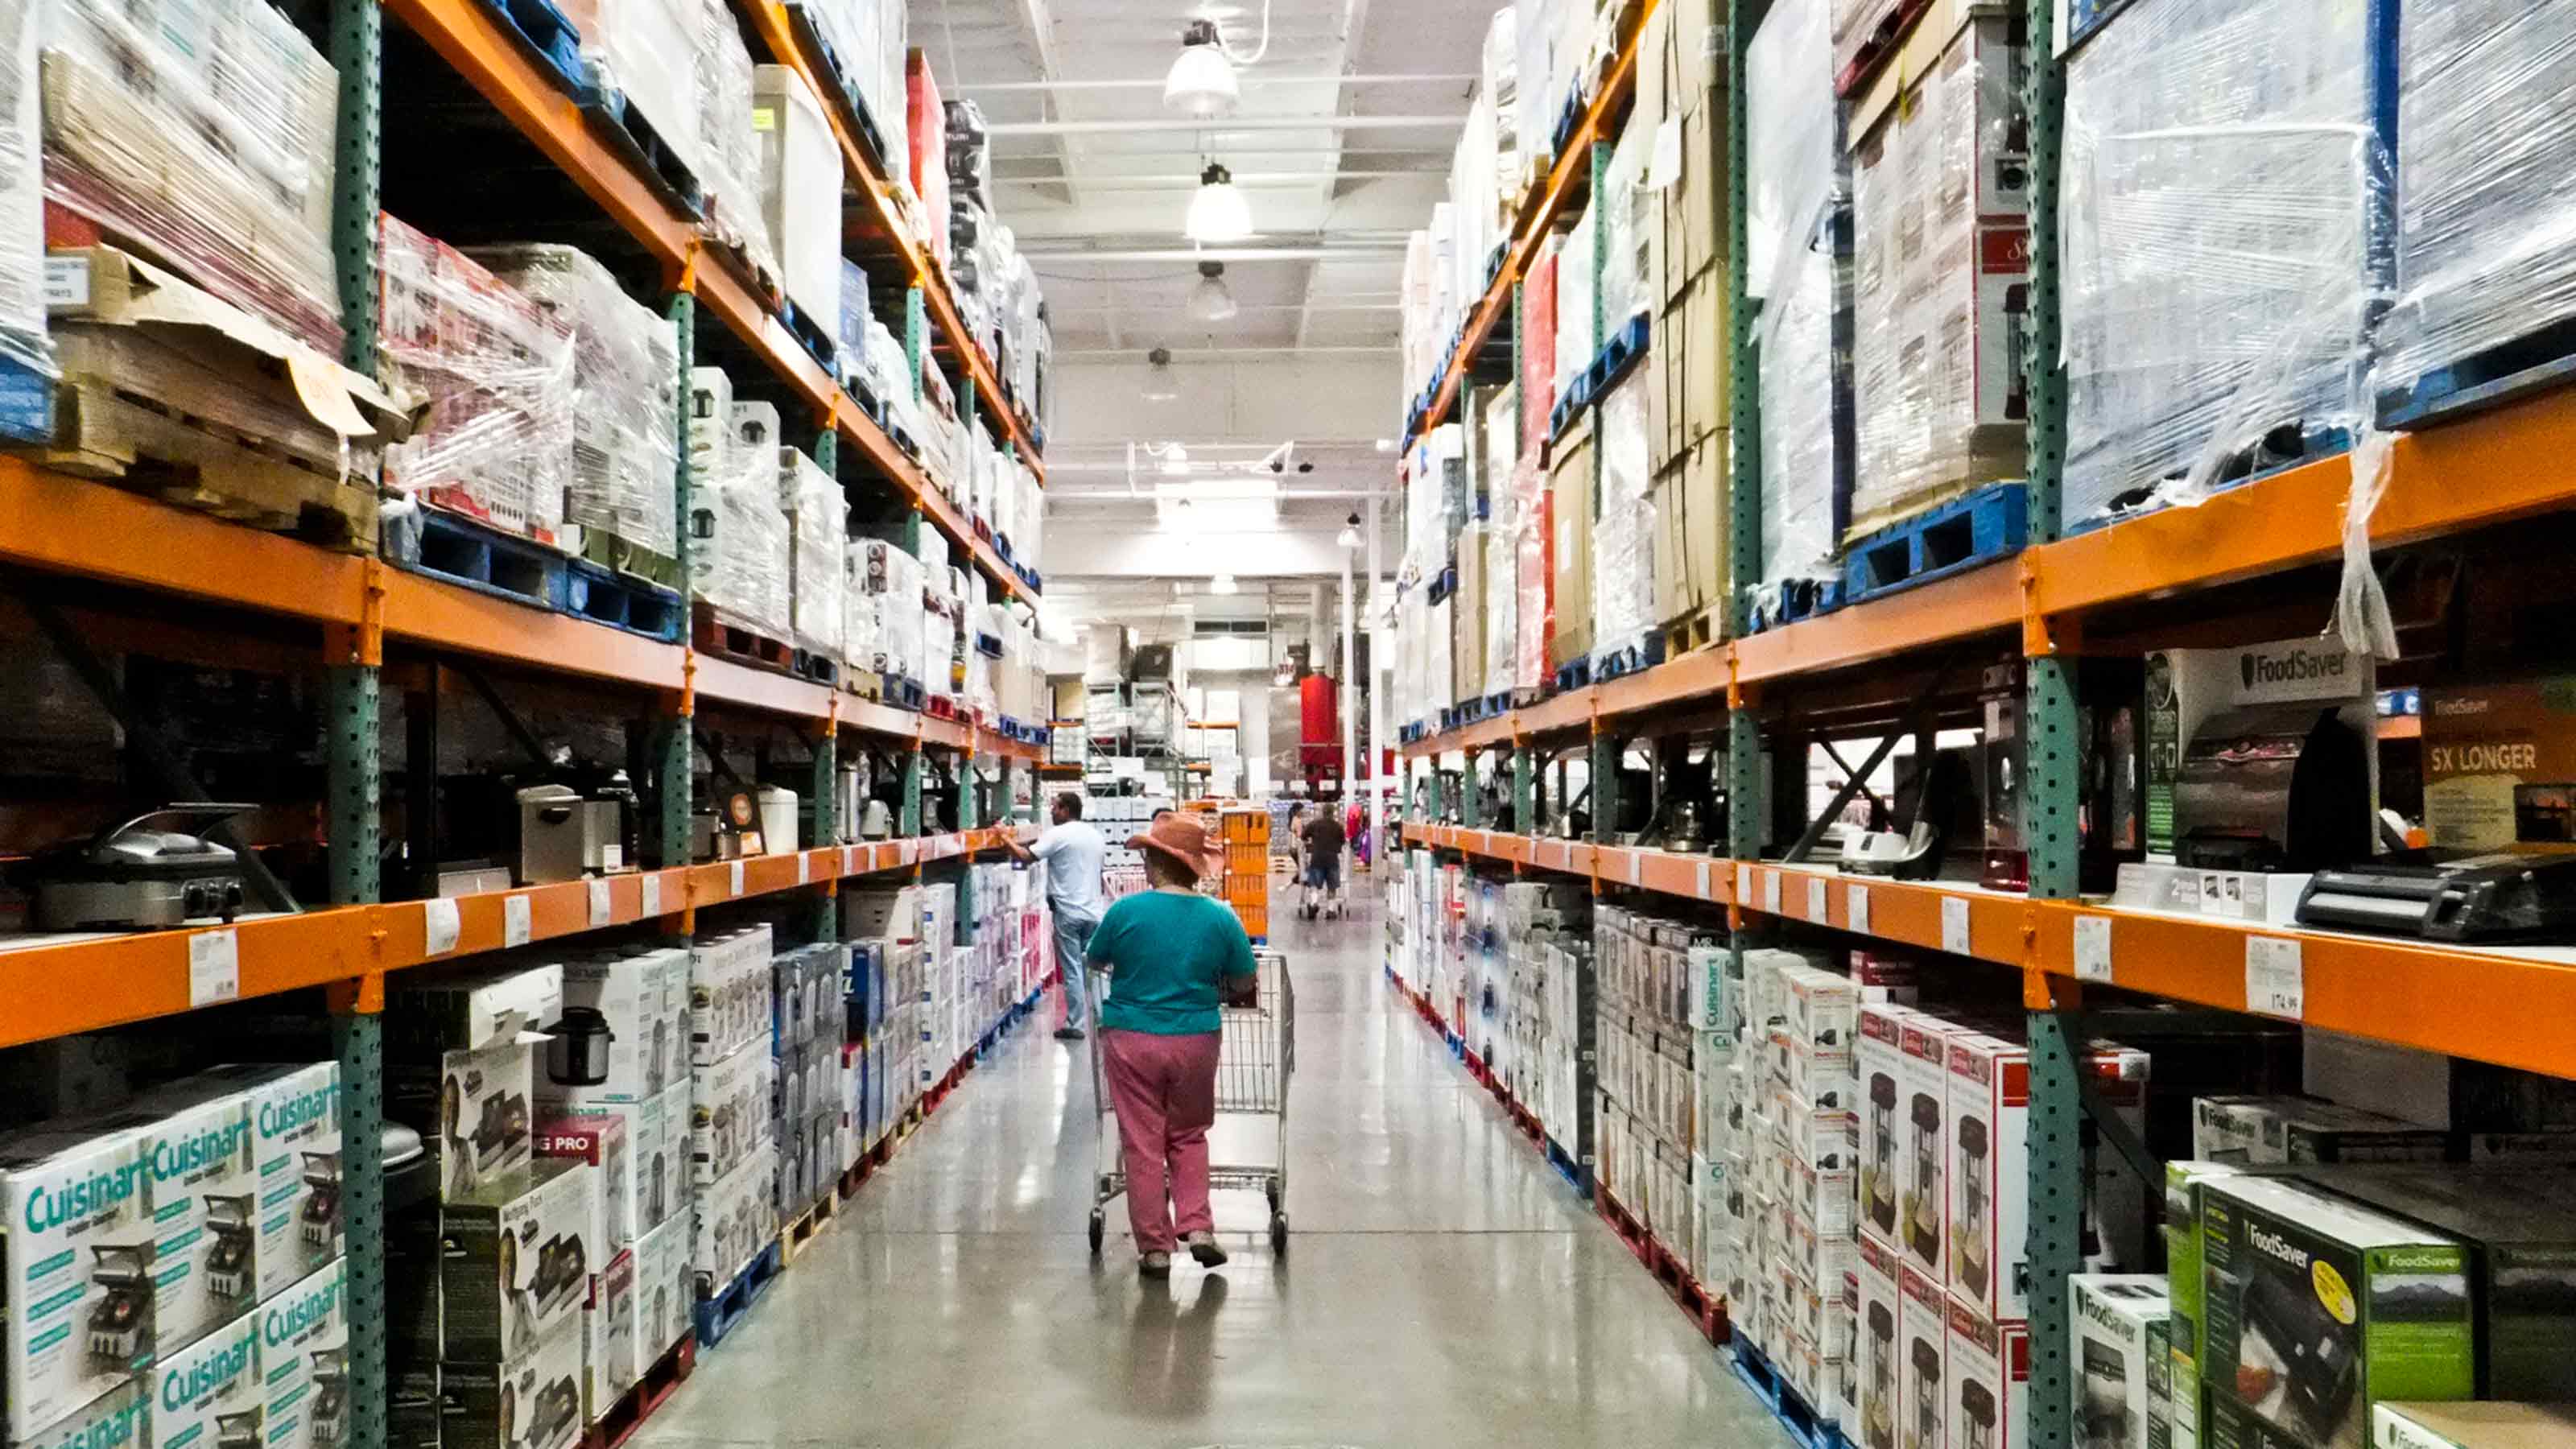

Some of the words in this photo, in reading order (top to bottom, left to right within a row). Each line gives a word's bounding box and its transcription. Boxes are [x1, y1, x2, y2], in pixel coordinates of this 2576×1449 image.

[2256, 650, 2346, 683] FoodSaver
[2459, 744, 2536, 770] LONGER
[259, 1080, 341, 1139] Cuisinart
[152, 1116, 252, 1182] Cuisinart
[555, 1137, 589, 1151] PRO
[26, 1156, 153, 1234] Cuisinart
[2250, 1223, 2309, 1269] FoodSaver
[2388, 1254, 2461, 1268] FoodSaver
[265, 1274, 347, 1348] Cuisinart
[2085, 1292, 2136, 1343] FoodSaver
[163, 1329, 258, 1412] Cuisinart
